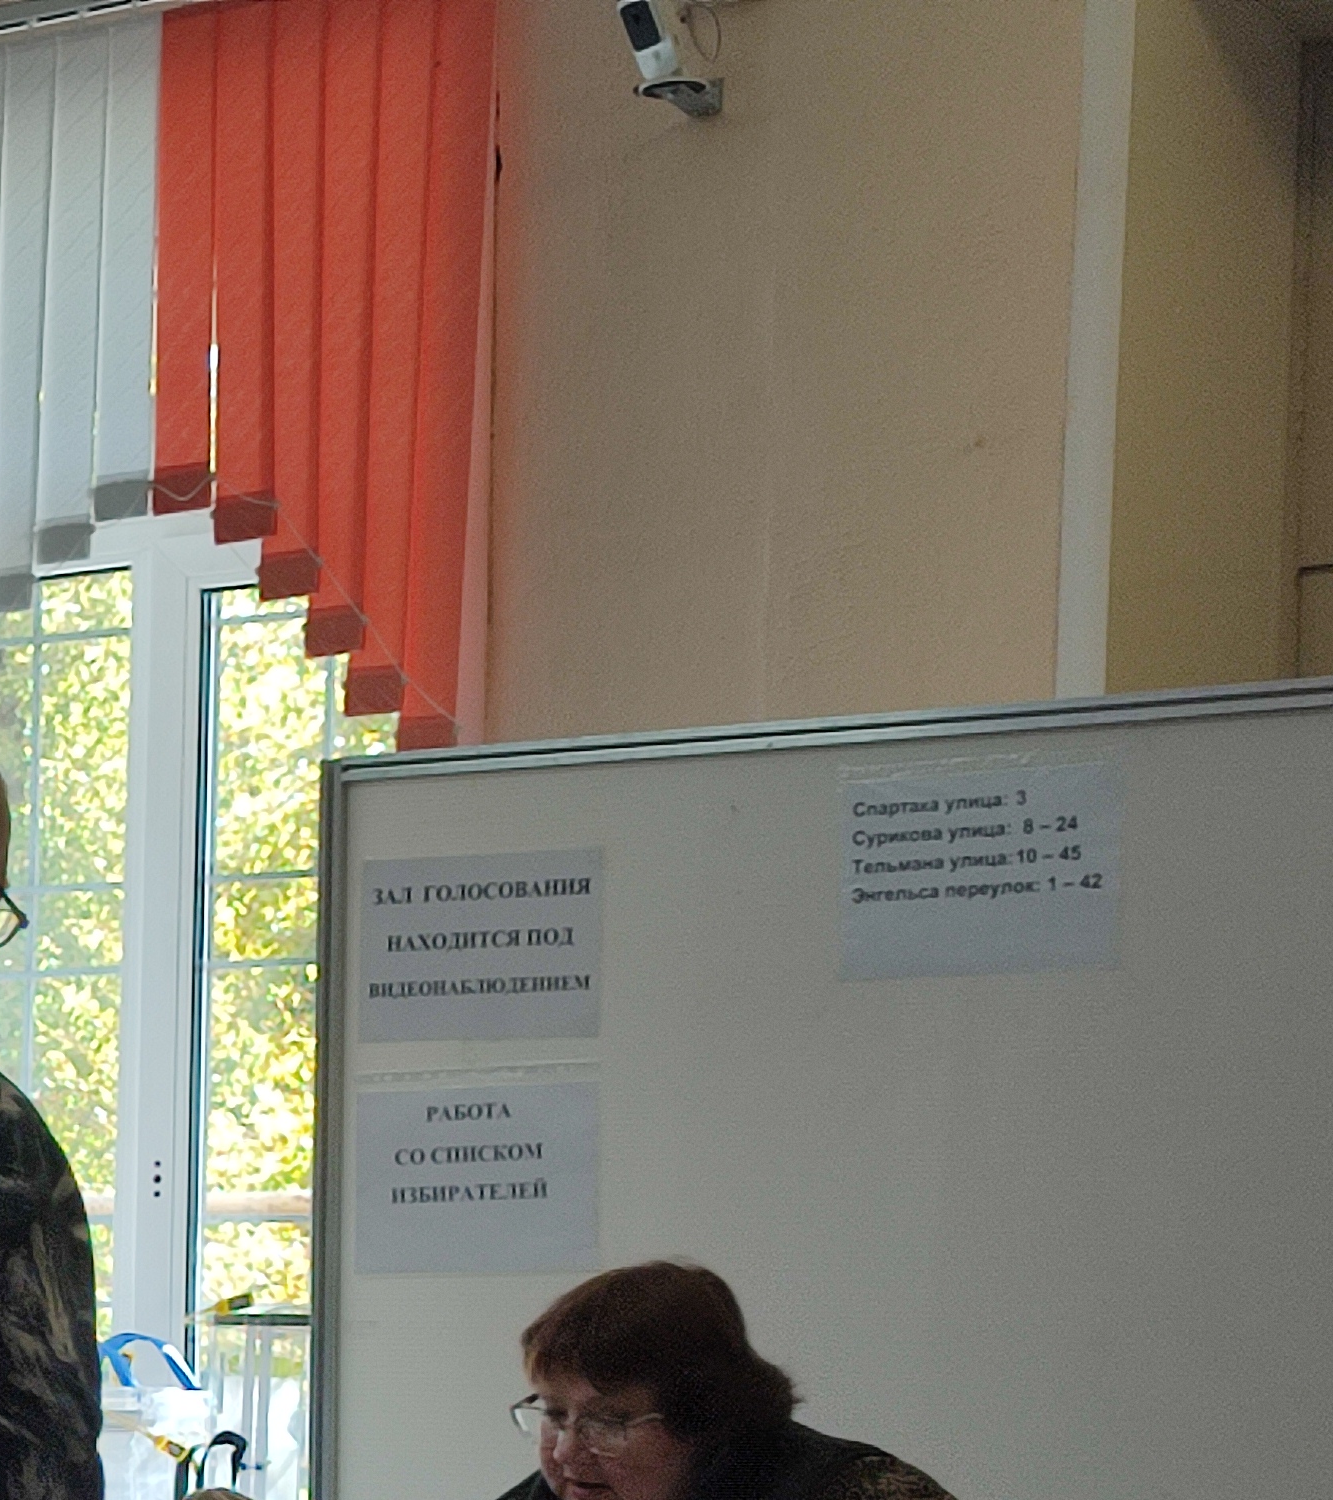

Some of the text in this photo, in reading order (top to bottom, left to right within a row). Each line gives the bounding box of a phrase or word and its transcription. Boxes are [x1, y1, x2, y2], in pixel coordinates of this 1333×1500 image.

[852, 790, 1027, 818] Спартака улица: 3
[852, 827, 942, 849] Сурикова
[948, 823, 1012, 844] улица:
[1023, 818, 1033, 834] 8
[1055, 816, 1078, 832] 24
[852, 857, 944, 875] Тельмана
[1017, 849, 1037, 864] 10
[1059, 845, 1081, 861] 45
[373, 878, 591, 905] ЗАЛ ГОЛОСОВАНИЯ
[852, 884, 939, 904] Энгельса
[945, 880, 1040, 899] переулок:
[1048, 877, 1056, 891] 1
[1079, 873, 1102, 889] 42
[386, 927, 575, 953] НАХОДИТСЯ ПОД
[368, 975, 590, 998] ВИДЕОНАБЛЮДЕНИЕМ
[426, 1103, 512, 1122] РАБОТА
[395, 1143, 543, 1165] СО СПИСКОМ
[392, 1178, 547, 1205] ИЗБИРАТЕЛЕЙ
